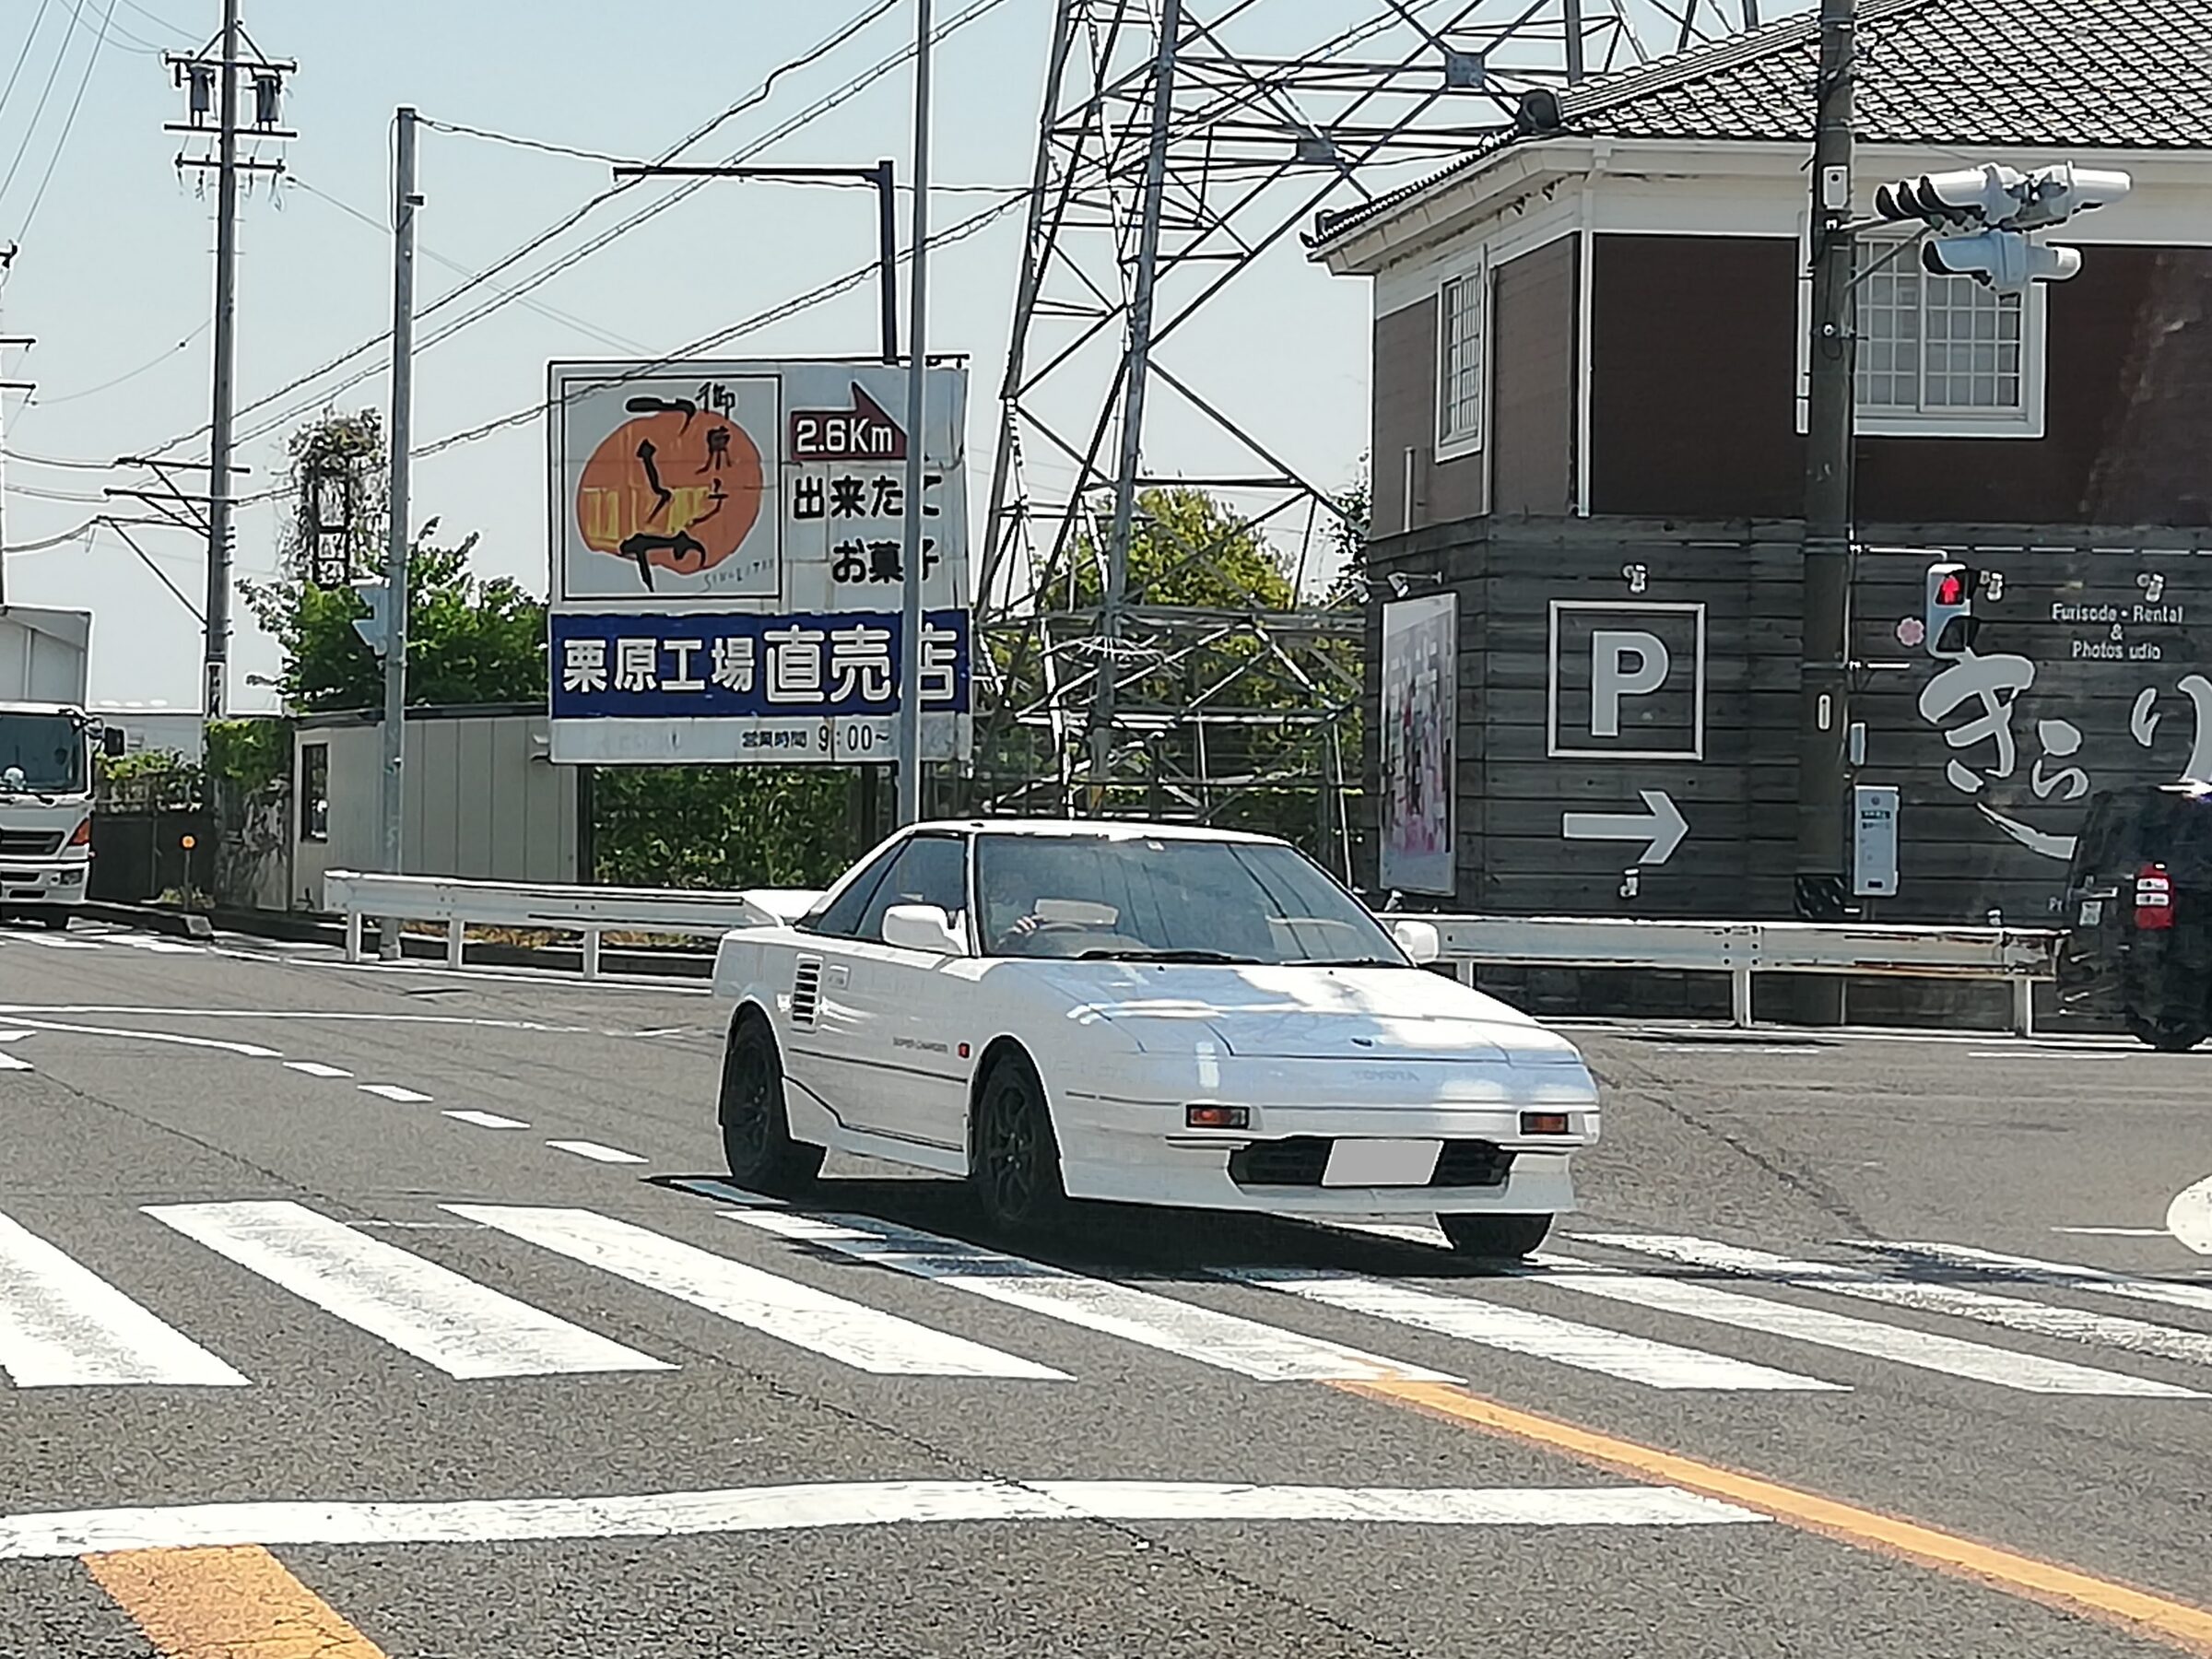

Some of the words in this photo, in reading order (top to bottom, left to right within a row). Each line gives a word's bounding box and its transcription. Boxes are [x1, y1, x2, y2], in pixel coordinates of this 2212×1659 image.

[796, 418, 893, 453] 2.6Km
[2133, 605, 2183, 623] Rental
[2110, 623, 2124, 641] &
[1591, 630, 1670, 736] P
